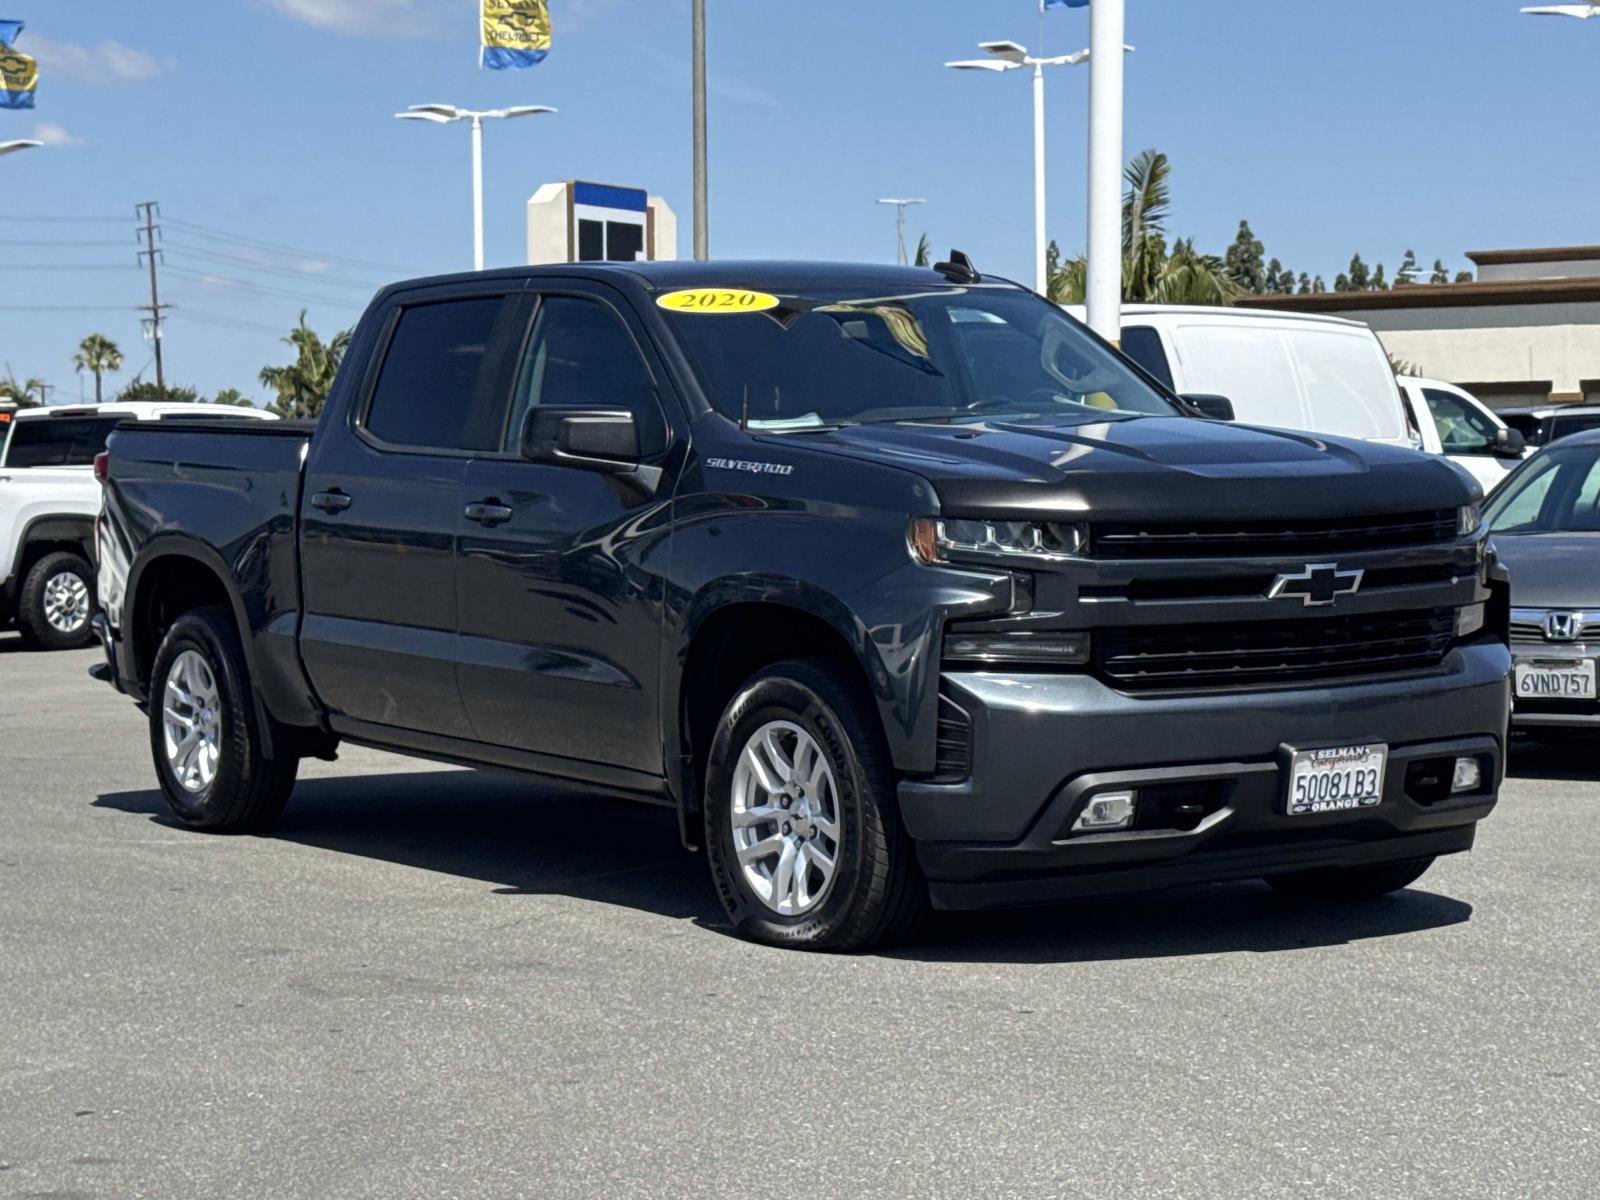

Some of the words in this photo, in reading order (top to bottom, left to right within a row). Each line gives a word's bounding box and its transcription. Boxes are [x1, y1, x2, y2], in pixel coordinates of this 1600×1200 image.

[680, 293, 757, 308] 2020
[705, 458, 794, 475] SILVERADO
[1521, 673, 1590, 694] 6VND757
[1317, 747, 1364, 759] SELMAN
[1296, 768, 1378, 804] 50081B3
[1311, 798, 1360, 813] ORANGE
